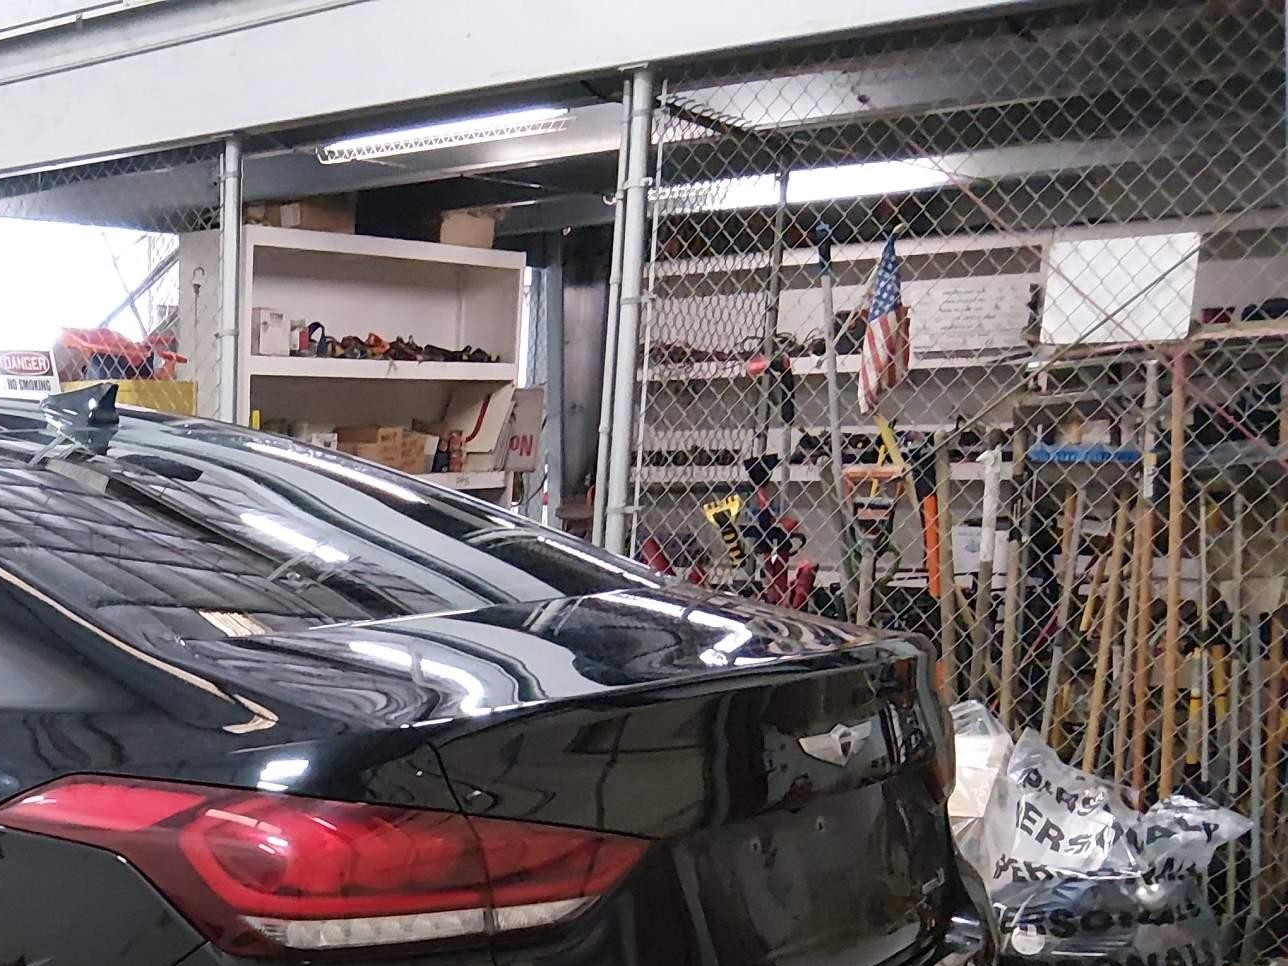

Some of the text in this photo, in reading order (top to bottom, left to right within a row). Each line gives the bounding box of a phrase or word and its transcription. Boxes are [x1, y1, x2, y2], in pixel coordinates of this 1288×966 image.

[4, 355, 47, 371] DANGER
[6, 379, 52, 391] NO SMOKING
